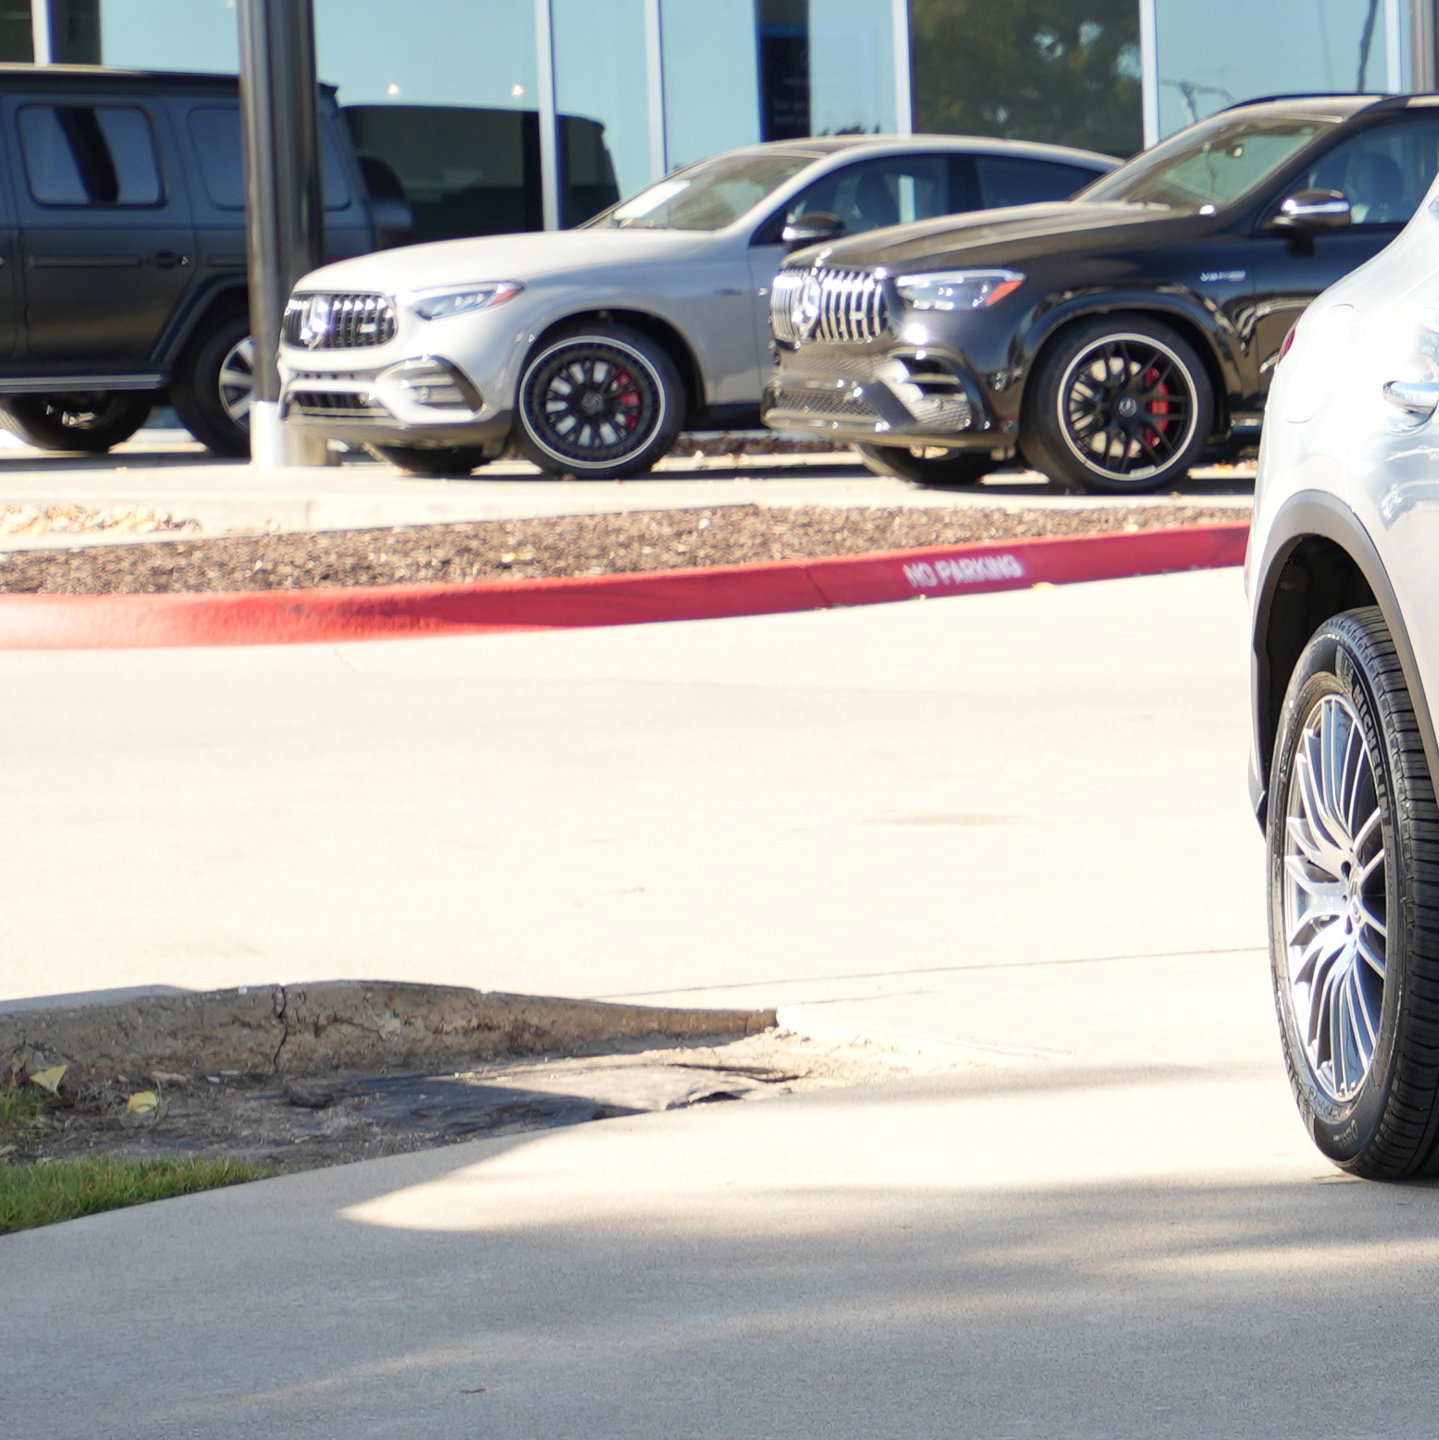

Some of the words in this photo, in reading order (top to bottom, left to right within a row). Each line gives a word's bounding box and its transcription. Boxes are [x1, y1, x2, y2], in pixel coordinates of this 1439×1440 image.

[903, 562, 938, 589] NO
[934, 554, 1025, 585] PARKING
[1352, 682, 1391, 825] MICHELIN
